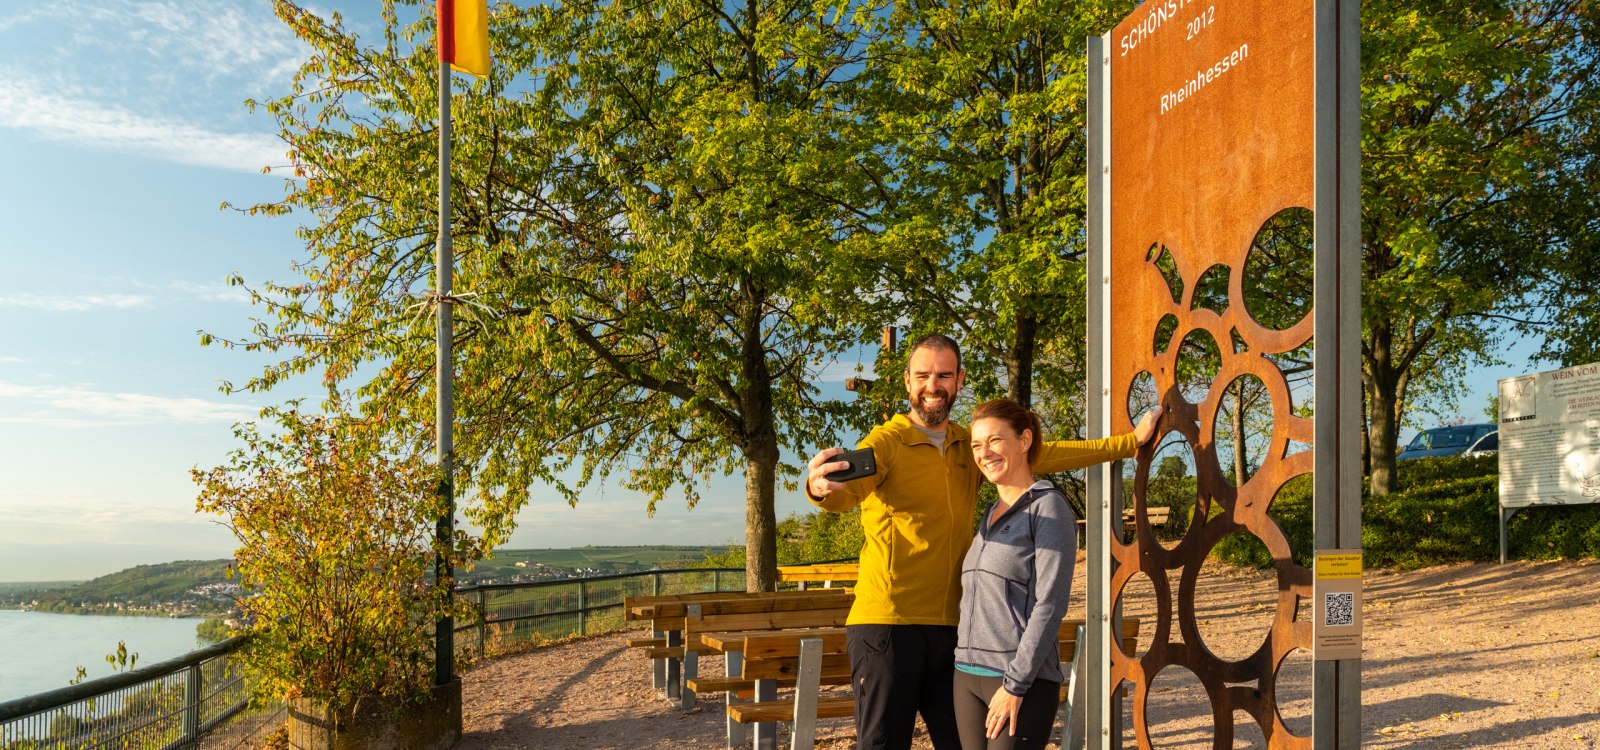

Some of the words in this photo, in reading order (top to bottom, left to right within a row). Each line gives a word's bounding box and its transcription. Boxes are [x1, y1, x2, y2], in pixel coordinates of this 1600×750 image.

[1121, 0, 1192, 57] SCHÖNS
[1187, 5, 1215, 41] 2012
[1160, 43, 1249, 115] Rheinhessen
[1552, 370, 1574, 381] WEIN
[1577, 366, 1598, 377] VOM
